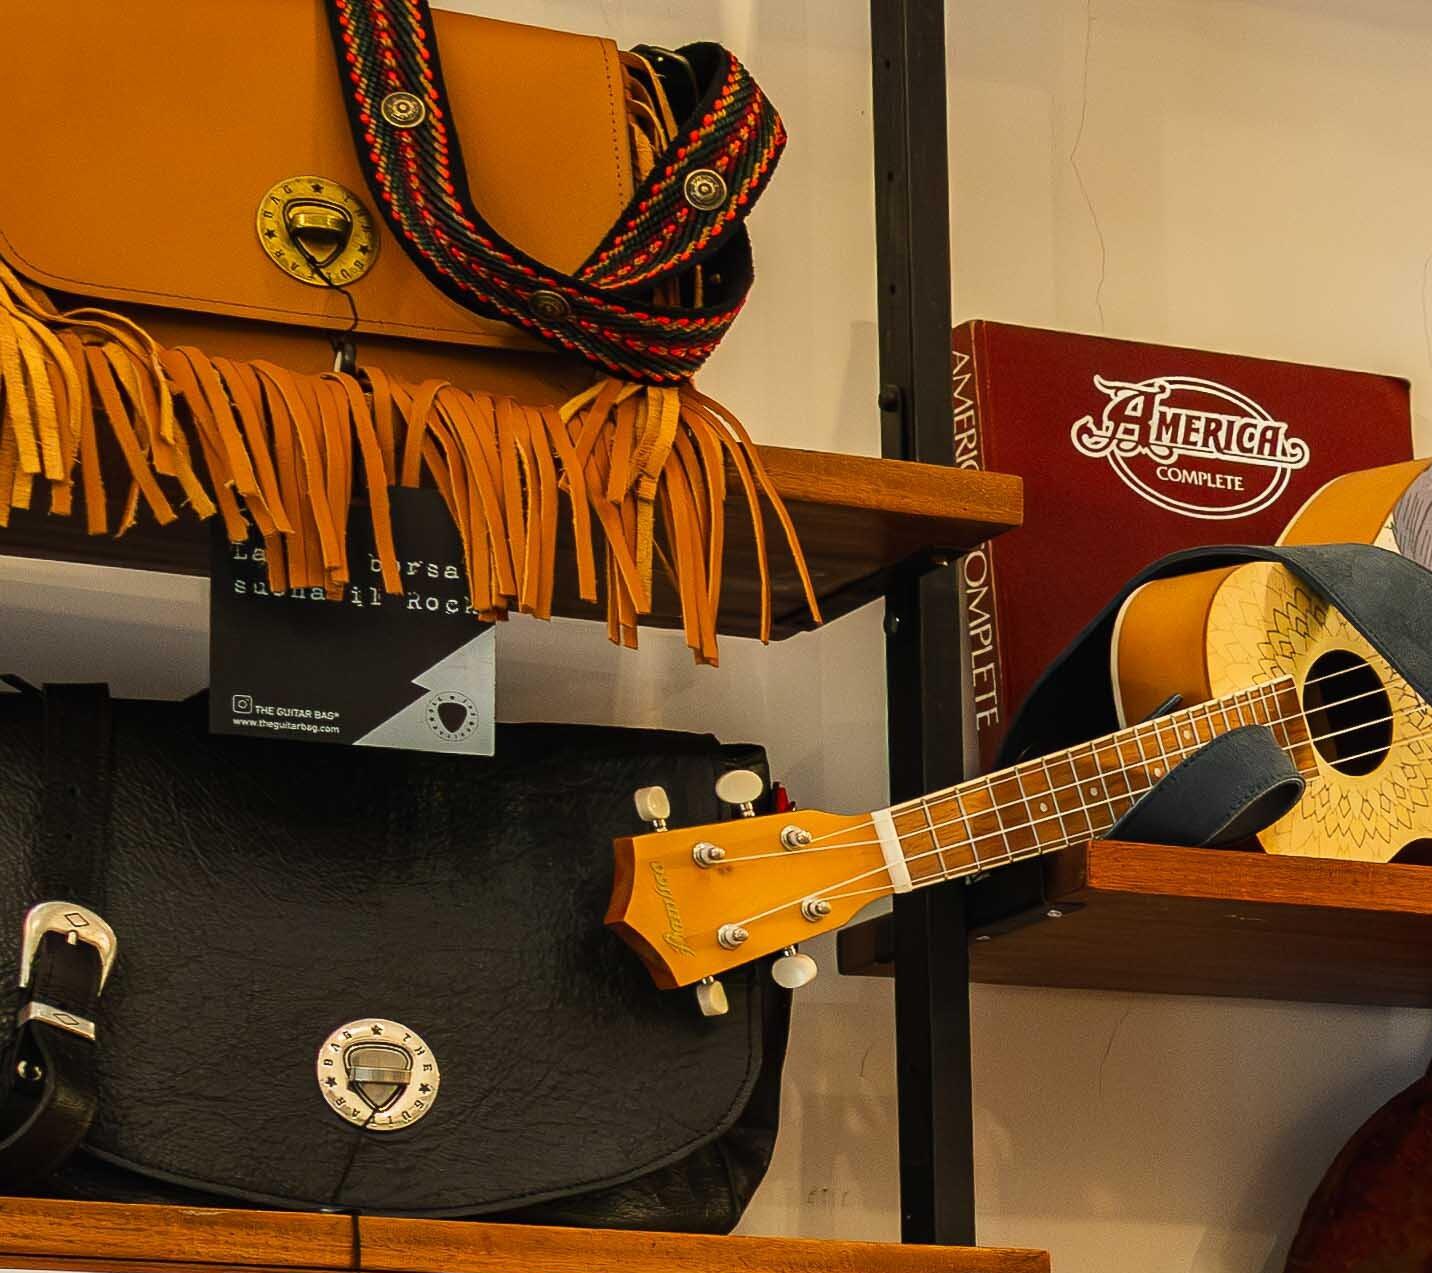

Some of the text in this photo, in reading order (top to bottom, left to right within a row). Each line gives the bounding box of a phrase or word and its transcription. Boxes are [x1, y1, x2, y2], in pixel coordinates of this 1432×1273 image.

[951, 350, 982, 471] AMERIC
[1070, 374, 1310, 470] AMERICA
[1156, 466, 1245, 492] COMPLETE
[962, 541, 1001, 733] OMPLETE
[233, 718, 340, 734] www.theguitarbag.com
[256, 705, 312, 718] THE GUITAR
